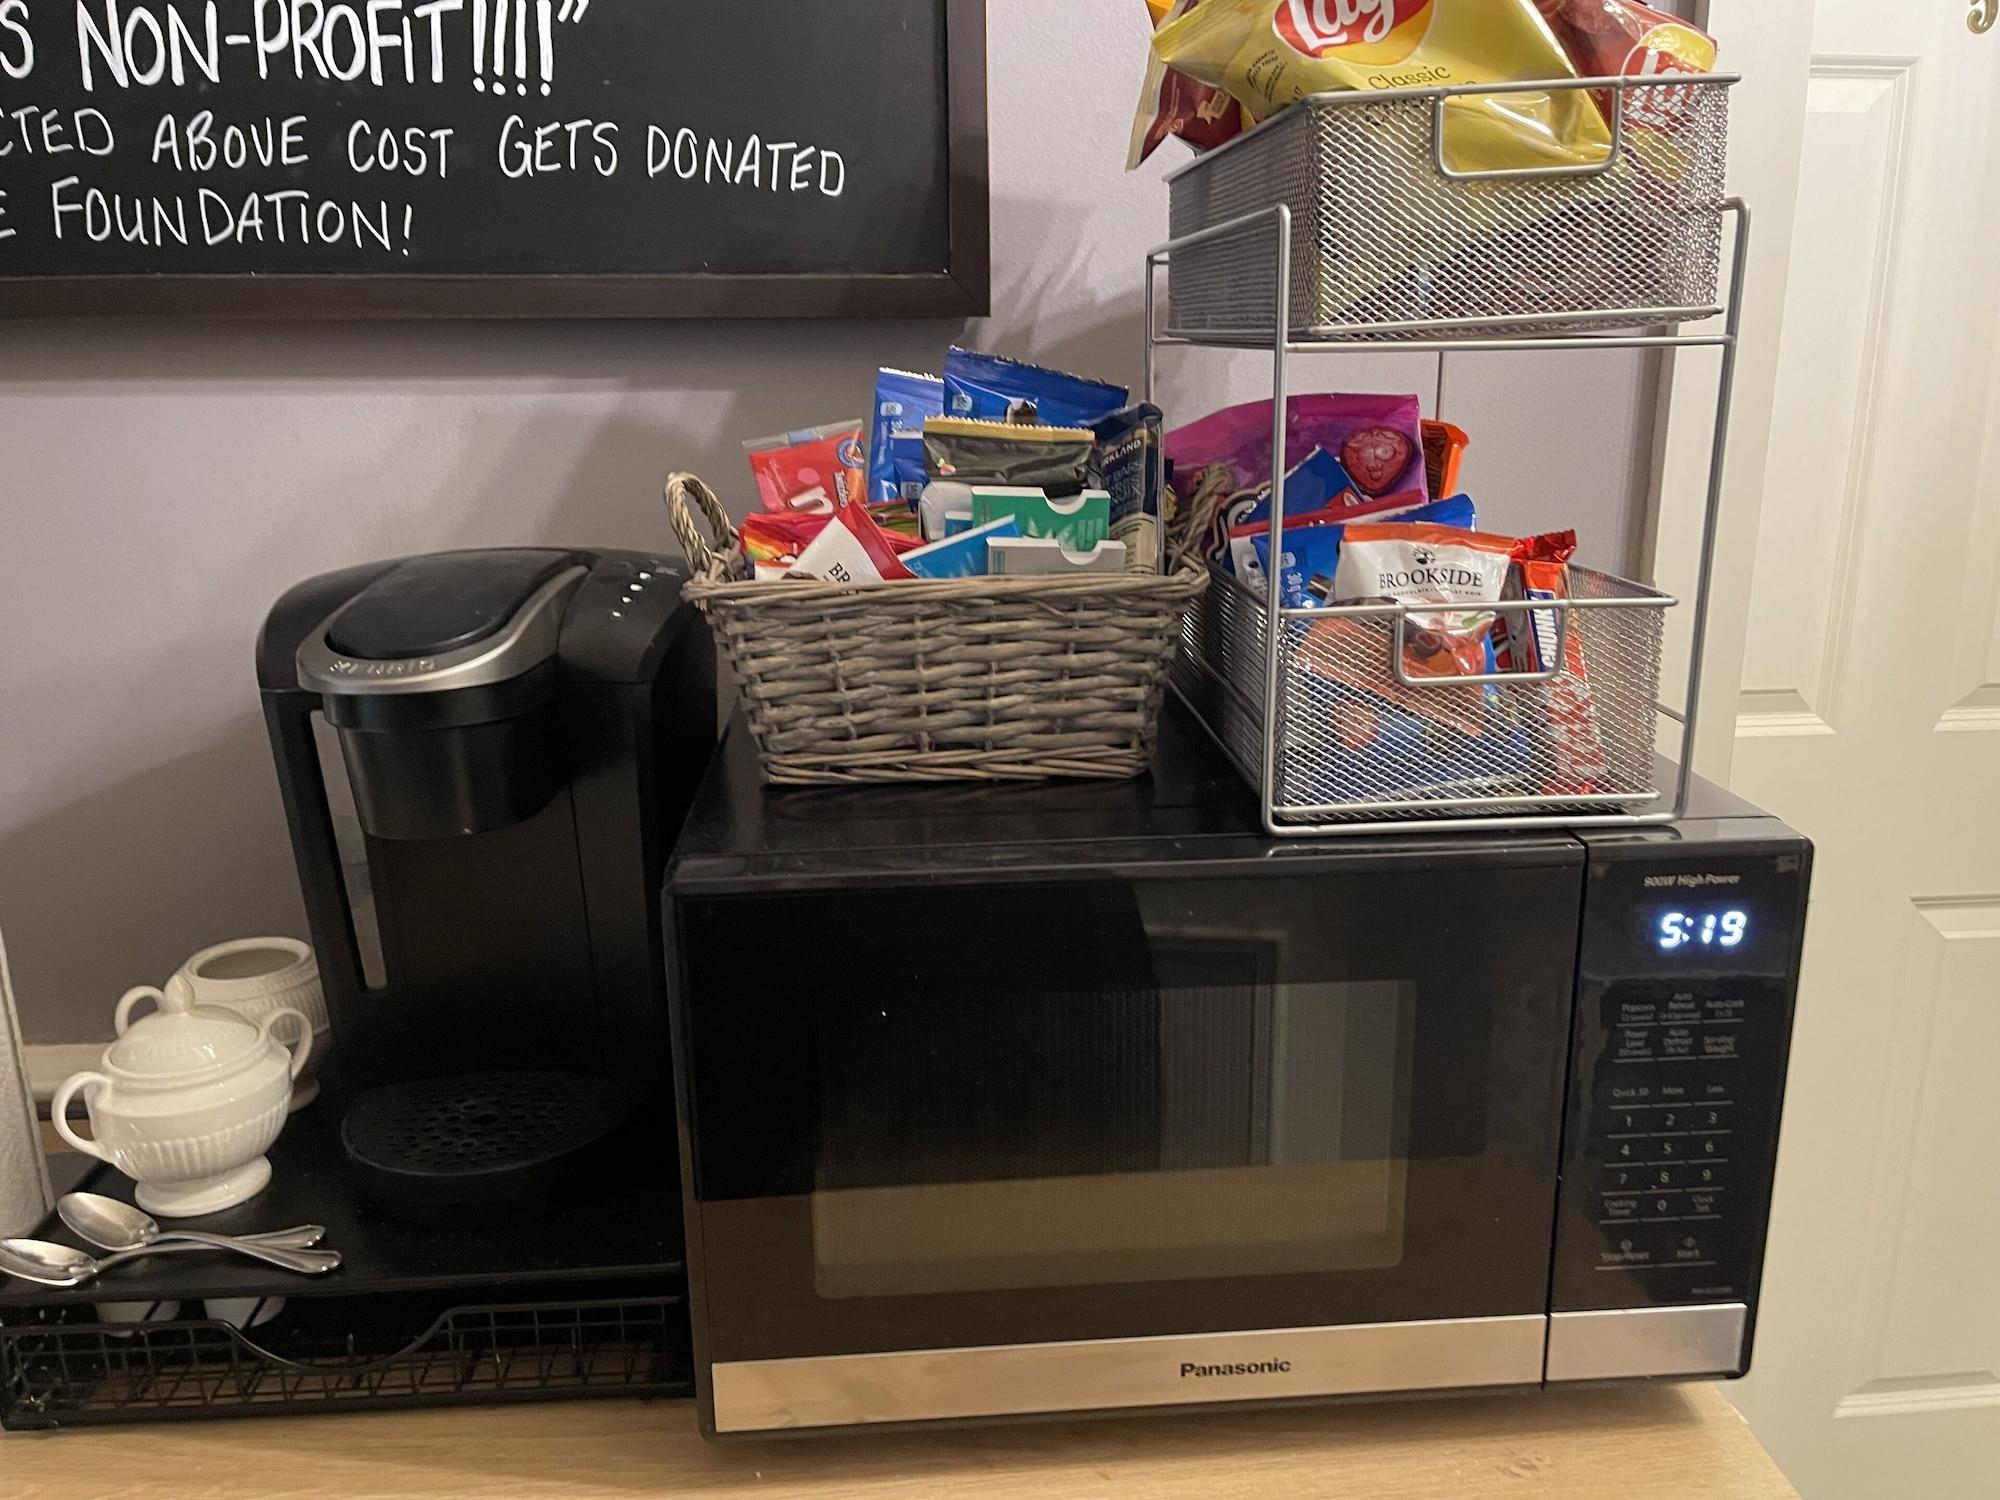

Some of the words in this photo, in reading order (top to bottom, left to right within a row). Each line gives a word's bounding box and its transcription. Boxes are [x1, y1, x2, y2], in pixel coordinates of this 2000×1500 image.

[1368, 66, 1451, 90] Classic
[152, 110, 309, 171] ABOVE
[348, 119, 454, 178] COST
[498, 114, 619, 178] GETS
[647, 124, 845, 197] DONATED
[51, 176, 413, 256] FOUNDATION!
[1103, 439, 1142, 466] RKLAND
[1379, 567, 1483, 589] BROOKSIDE
[1677, 874, 1705, 888] High
[1705, 873, 1742, 885] Power
[1660, 911, 1747, 949] 5:19
[1625, 1114, 1632, 1127] 1
[1665, 1113, 1676, 1127] 2
[1708, 1111, 1718, 1124] 3
[1620, 1144, 1631, 1156] 4
[1663, 1142, 1673, 1155] 5
[1704, 1140, 1714, 1153] 6
[1619, 1173, 1628, 1185] 7
[1660, 1171, 1670, 1183] 8
[1702, 1168, 1712, 1181] 9
[1656, 1199, 1667, 1212] 0
[1180, 1357, 1292, 1378] Panasonic
